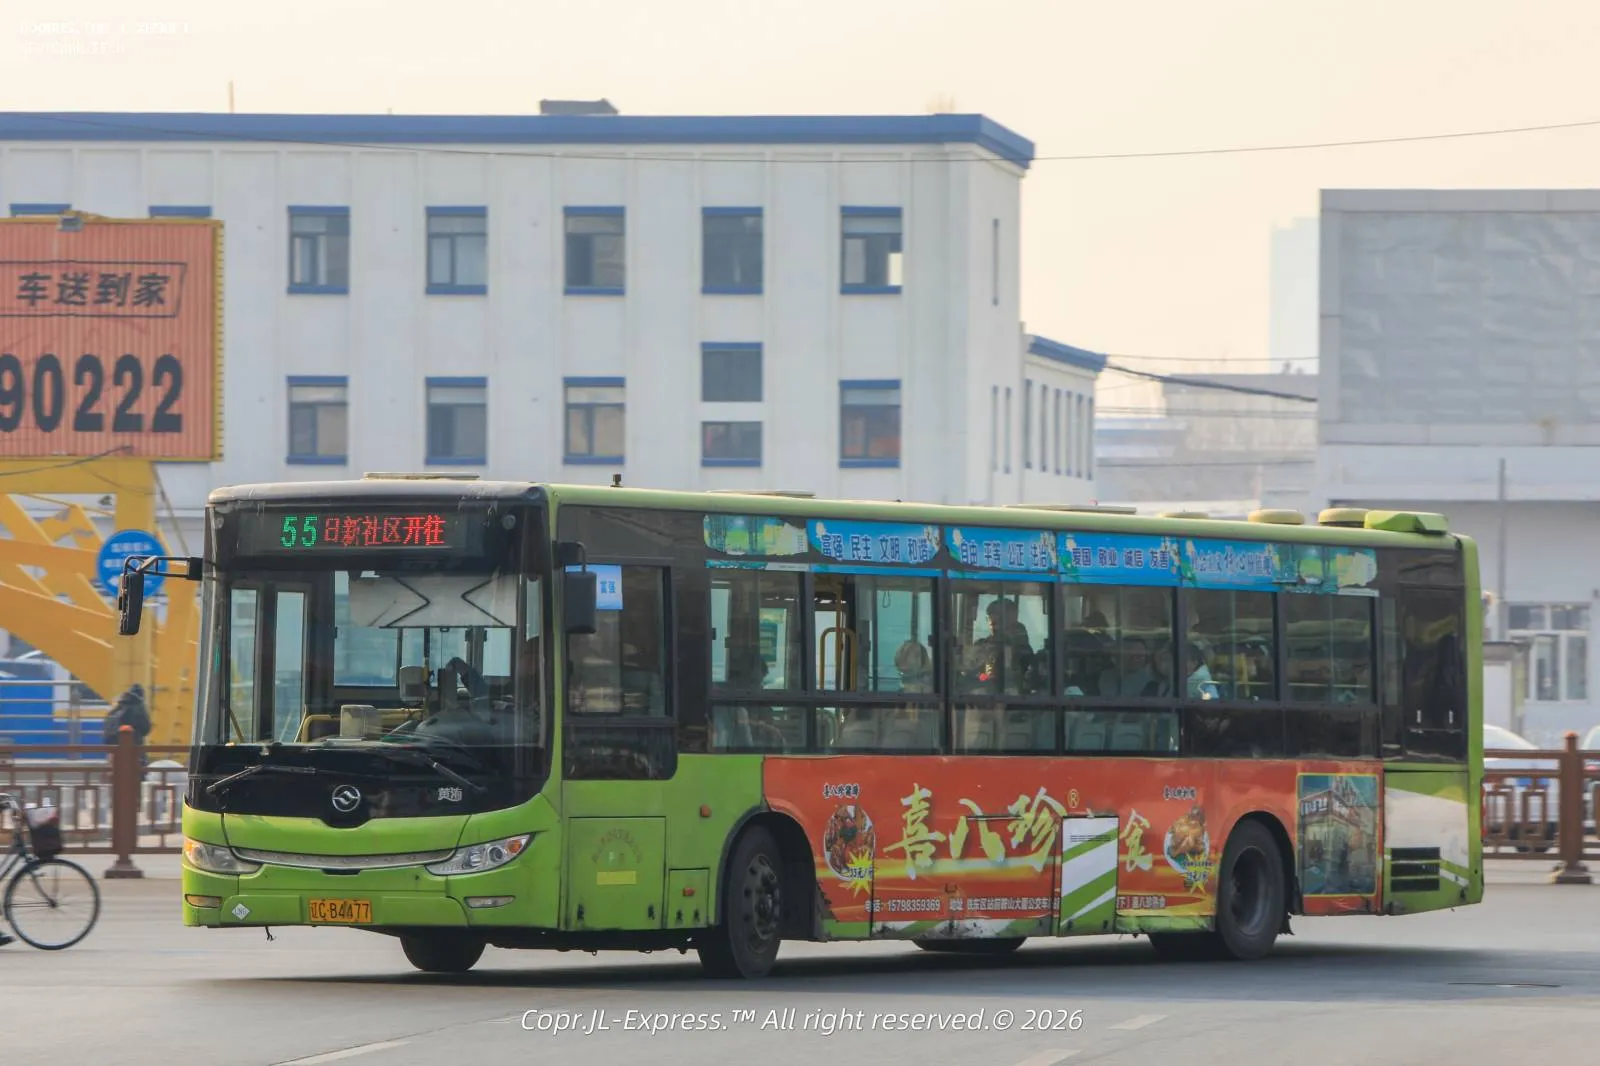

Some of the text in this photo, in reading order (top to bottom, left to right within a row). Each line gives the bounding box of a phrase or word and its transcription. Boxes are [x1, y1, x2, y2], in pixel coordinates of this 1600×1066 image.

[17, 271, 170, 307] 车送到家
[0, 354, 183, 433] 90222
[281, 515, 446, 547] 55 日新社区开往
[851, 535, 872, 559] 民主
[879, 536, 900, 560] 文明
[984, 542, 1001, 567] 平等
[1008, 543, 1025, 567] 公正
[1072, 548, 1092, 567] 爱国
[1150, 550, 1169, 570] 友善
